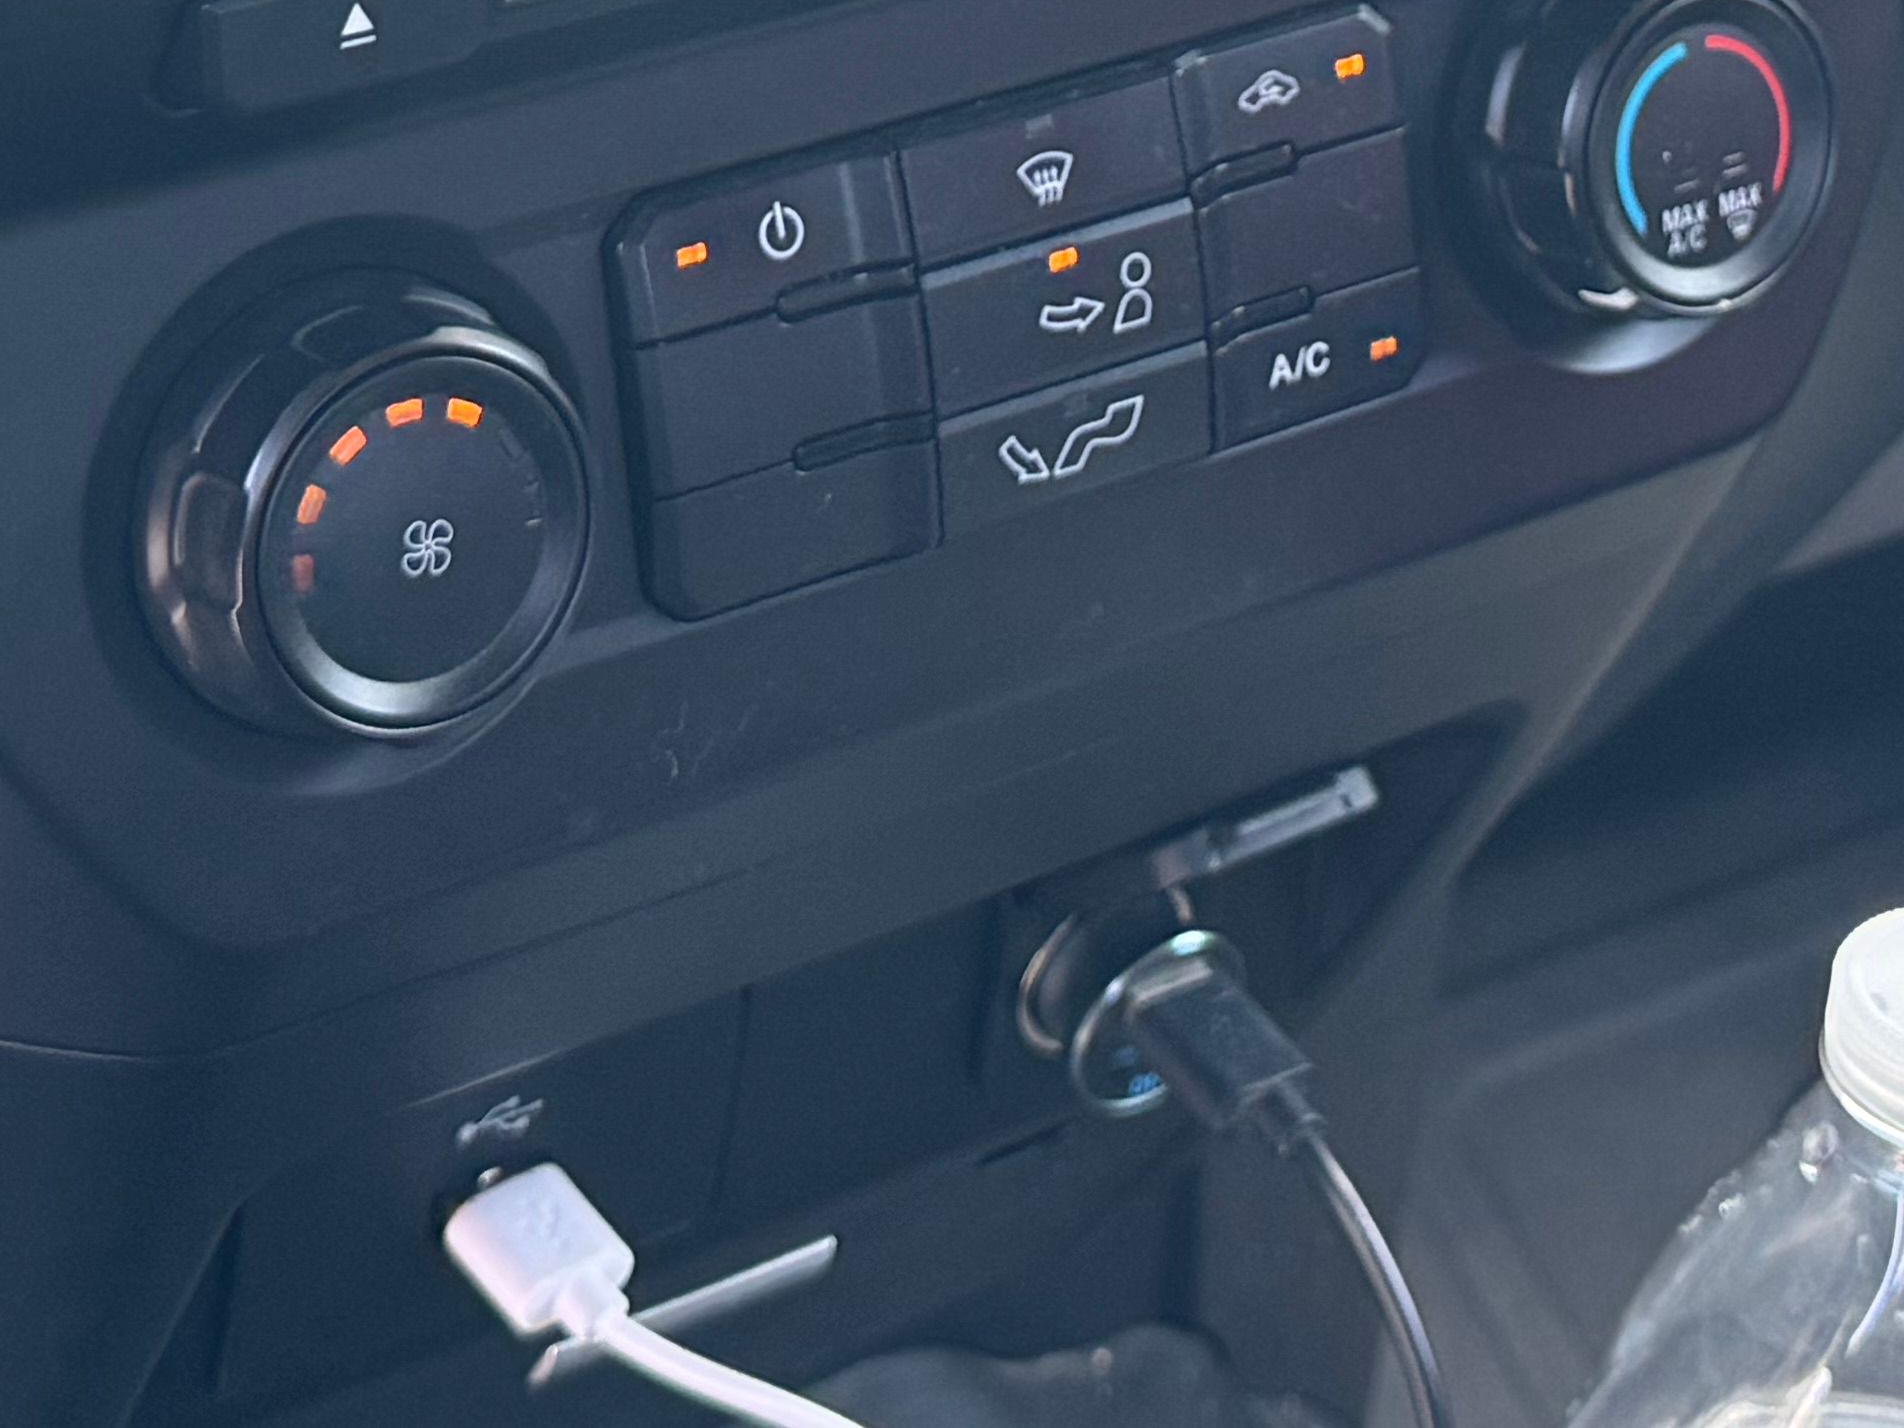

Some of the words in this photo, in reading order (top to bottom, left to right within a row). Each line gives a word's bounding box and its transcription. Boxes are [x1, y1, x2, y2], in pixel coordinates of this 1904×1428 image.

[1661, 199, 1710, 235] MAX
[1718, 181, 1764, 218] MAX
[1268, 340, 1331, 390] A/C
